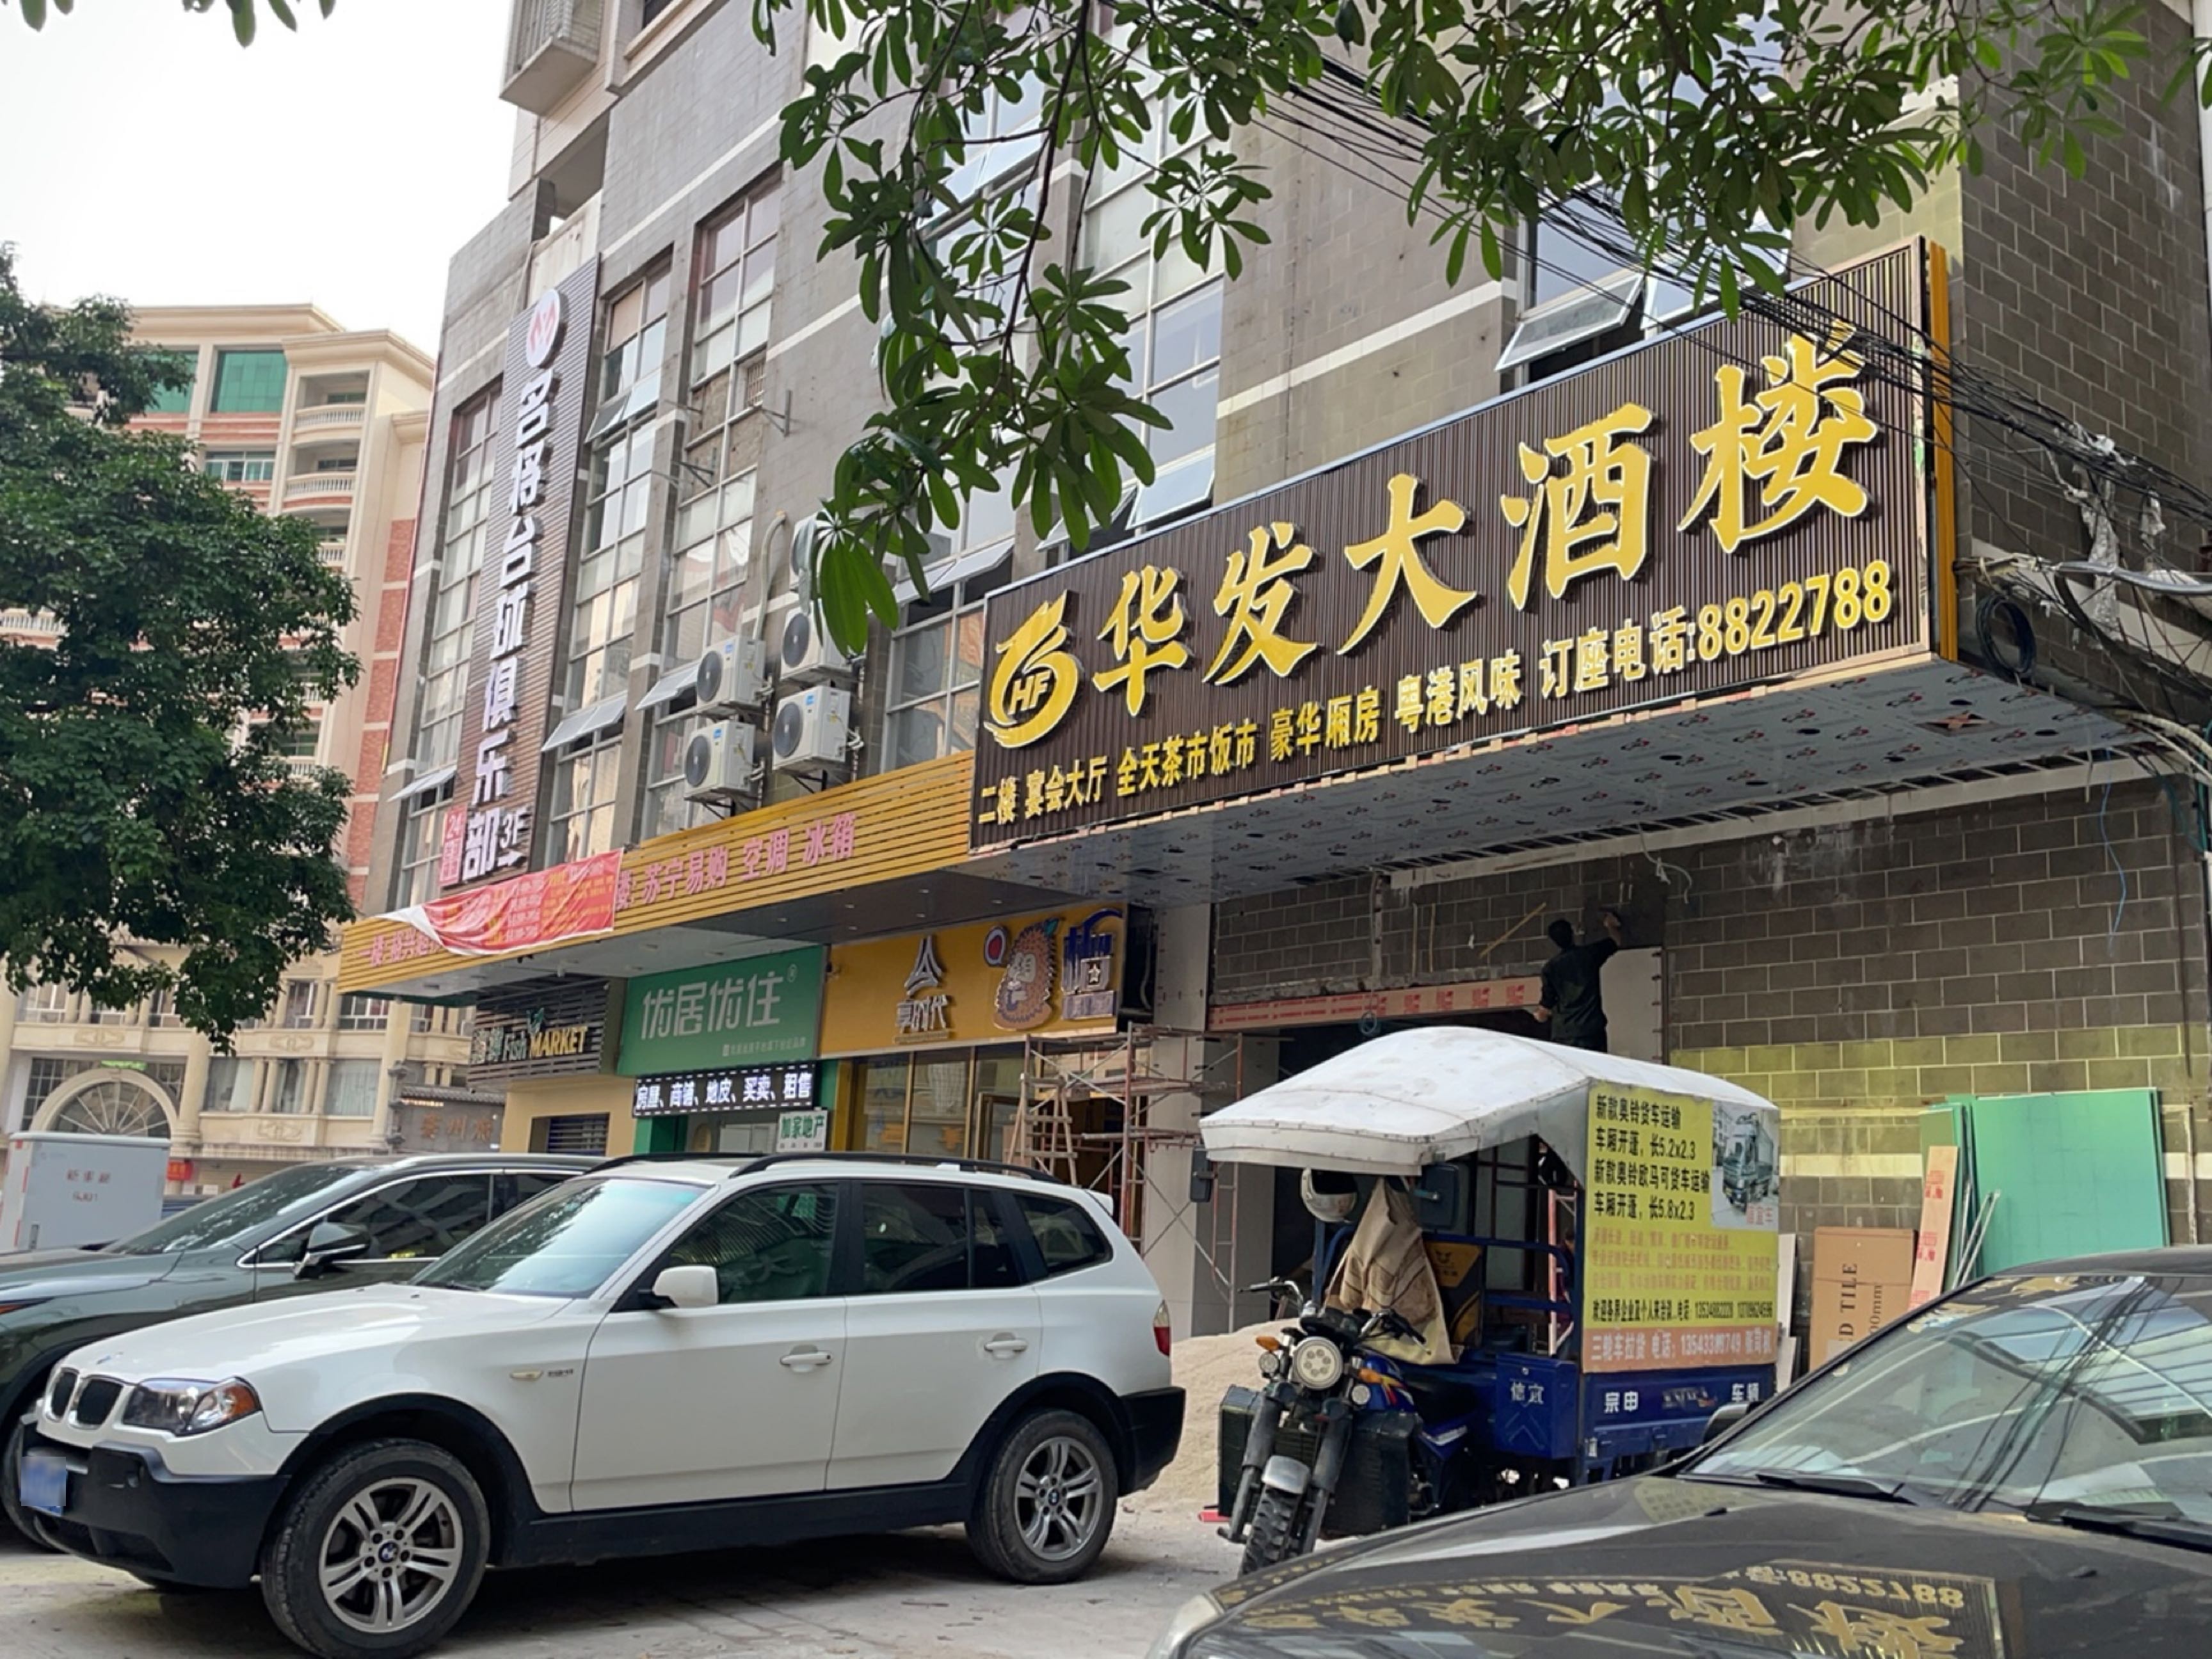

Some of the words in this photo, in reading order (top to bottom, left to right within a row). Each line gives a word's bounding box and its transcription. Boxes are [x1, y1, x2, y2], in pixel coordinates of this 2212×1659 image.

[1093, 321, 1879, 717] 华发大酒楼
[1025, 755, 1108, 820] 宴会大厅
[1118, 717, 1258, 797] 全天茶市饭市
[1270, 685, 1380, 761] 豪华厢房
[1395, 649, 1521, 733] 粤港风味
[642, 846, 729, 904] 苏宁易购
[741, 828, 790, 881] 空调
[803, 812, 856, 866] 冰箱
[530, 1024, 588, 1059] MARKET
[641, 971, 783, 1040] 优居优住
[1840, 1263, 1857, 1313] TILE
